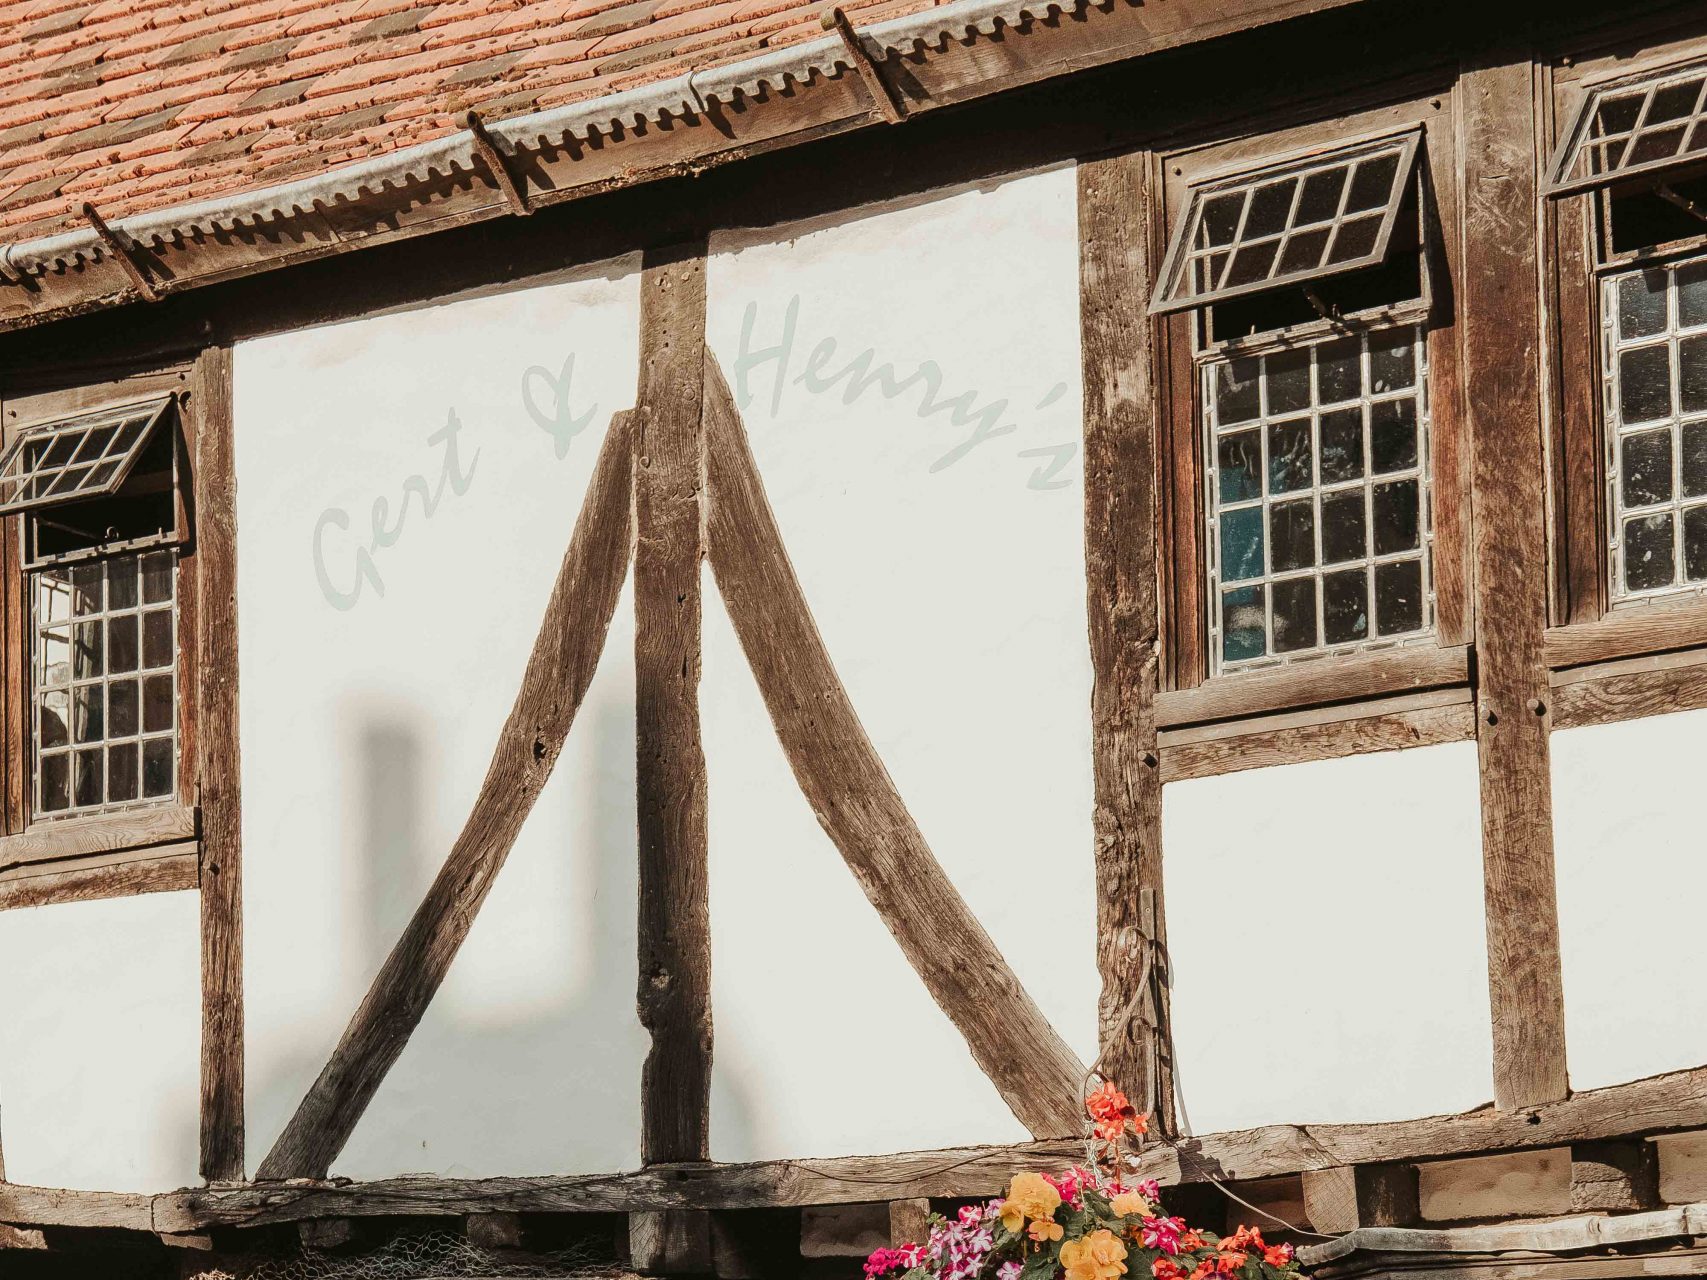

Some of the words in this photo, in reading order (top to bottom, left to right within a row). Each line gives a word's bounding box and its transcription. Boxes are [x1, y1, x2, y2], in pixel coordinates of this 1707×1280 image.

[313, 406, 481, 612] Gert
[521, 352, 598, 460] &
[735, 294, 1077, 490] Henry's
